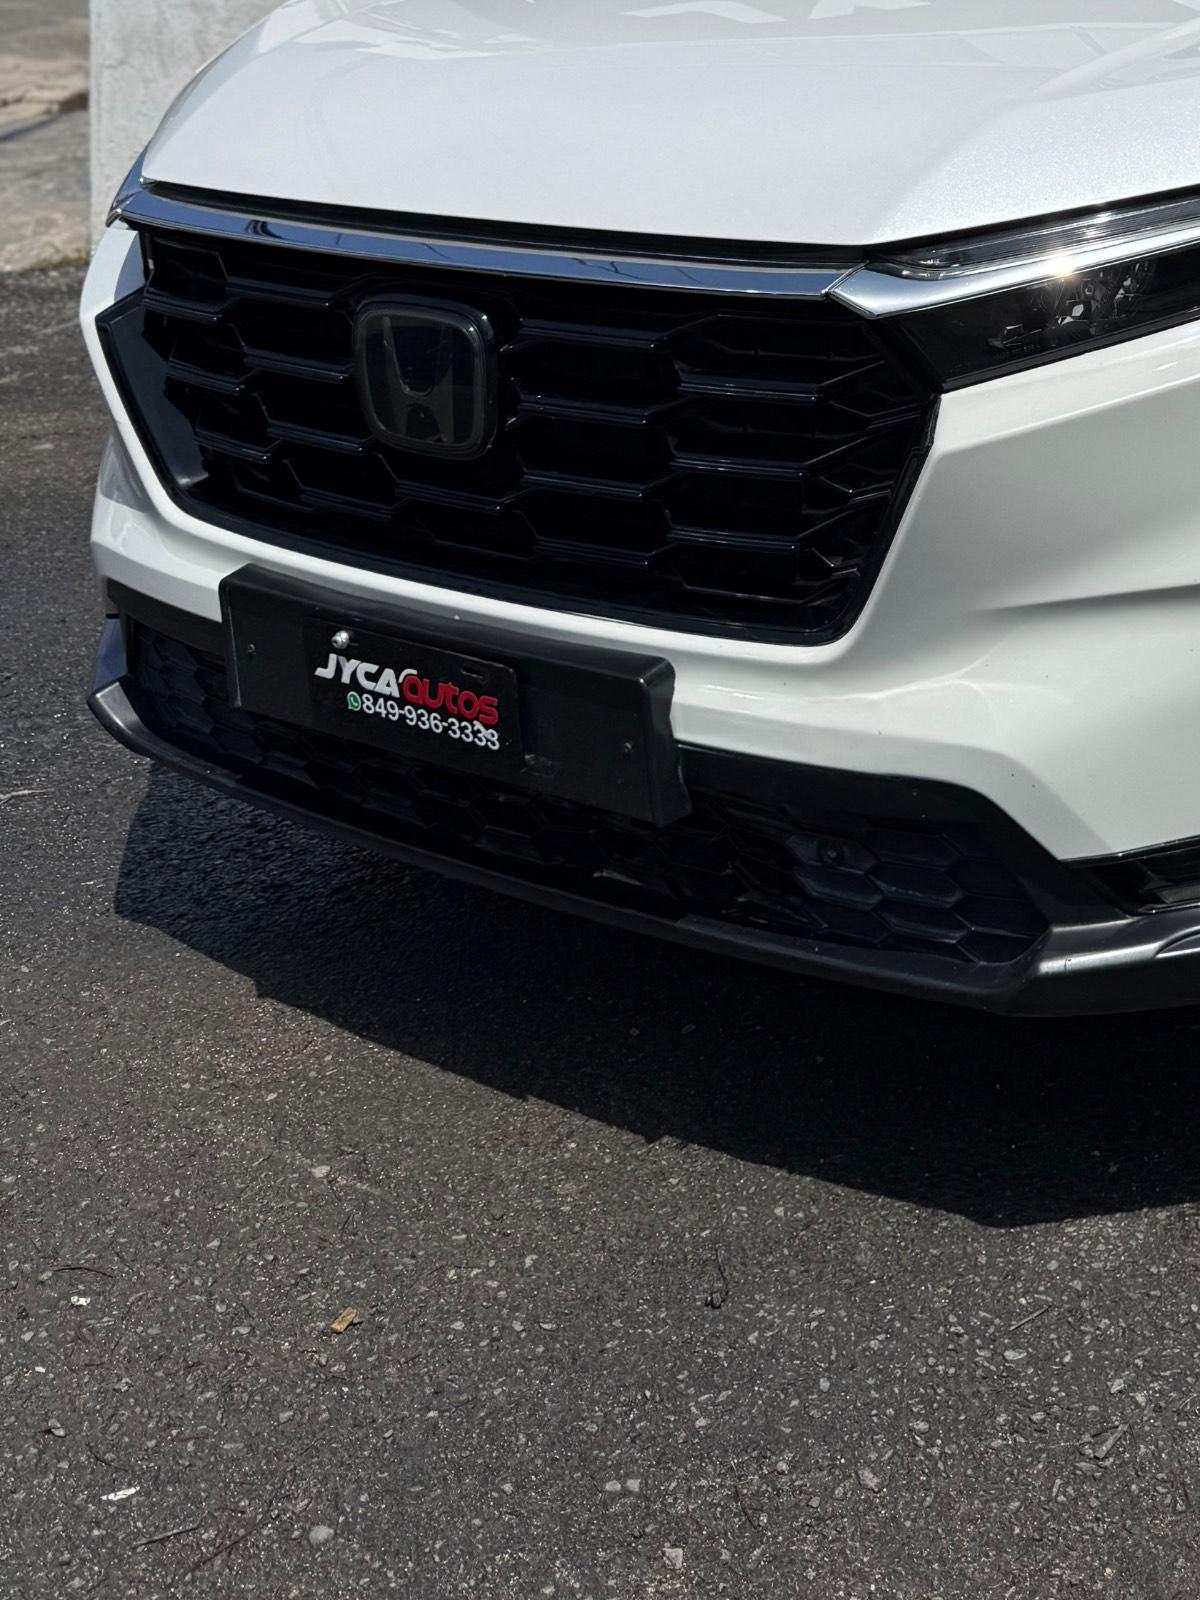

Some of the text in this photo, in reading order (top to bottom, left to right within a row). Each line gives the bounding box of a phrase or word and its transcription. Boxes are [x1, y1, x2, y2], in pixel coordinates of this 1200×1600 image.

[314, 653, 499, 725] JYCA autos
[361, 693, 500, 750] 849-936-3333
